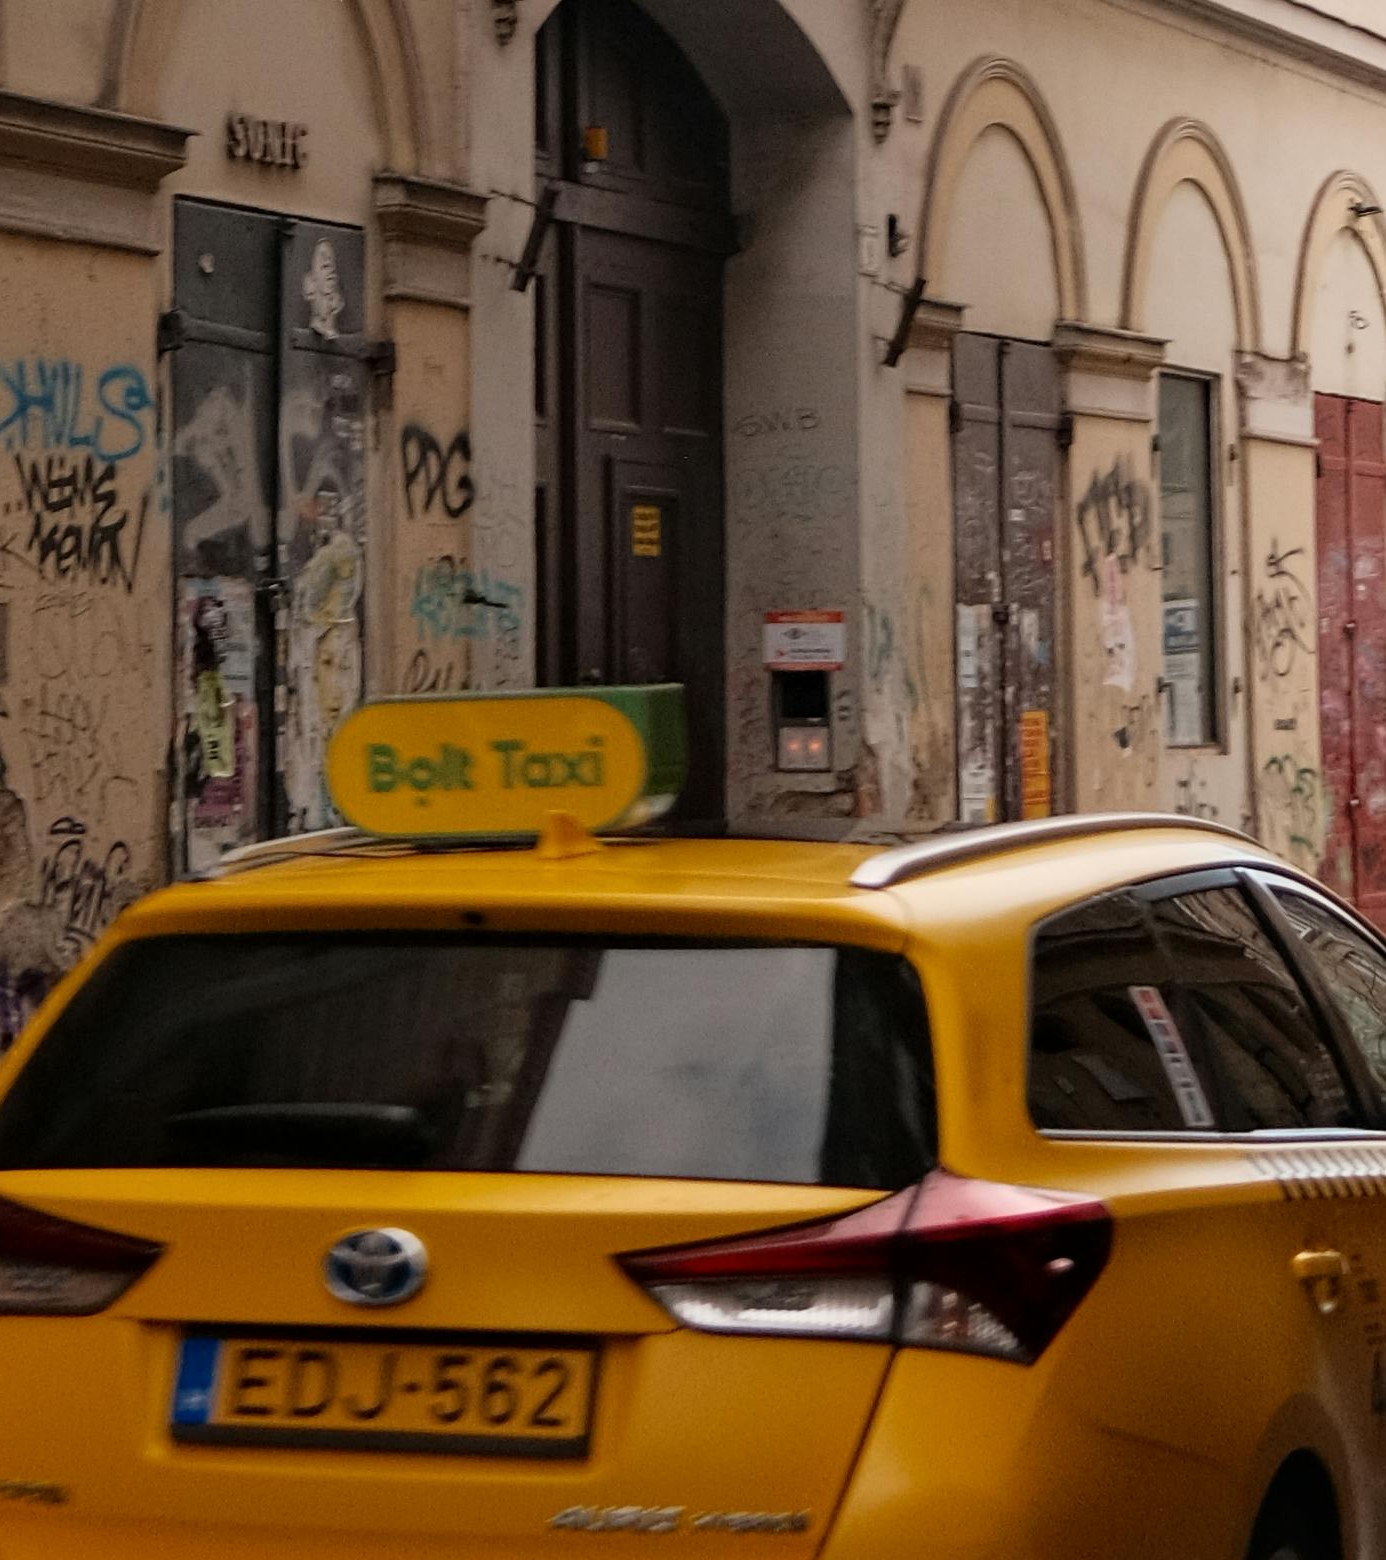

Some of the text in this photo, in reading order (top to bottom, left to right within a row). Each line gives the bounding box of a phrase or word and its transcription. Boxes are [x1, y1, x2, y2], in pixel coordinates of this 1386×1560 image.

[367, 735, 606, 807] Bolt Taxi
[232, 1347, 571, 1428] EDJ-562
